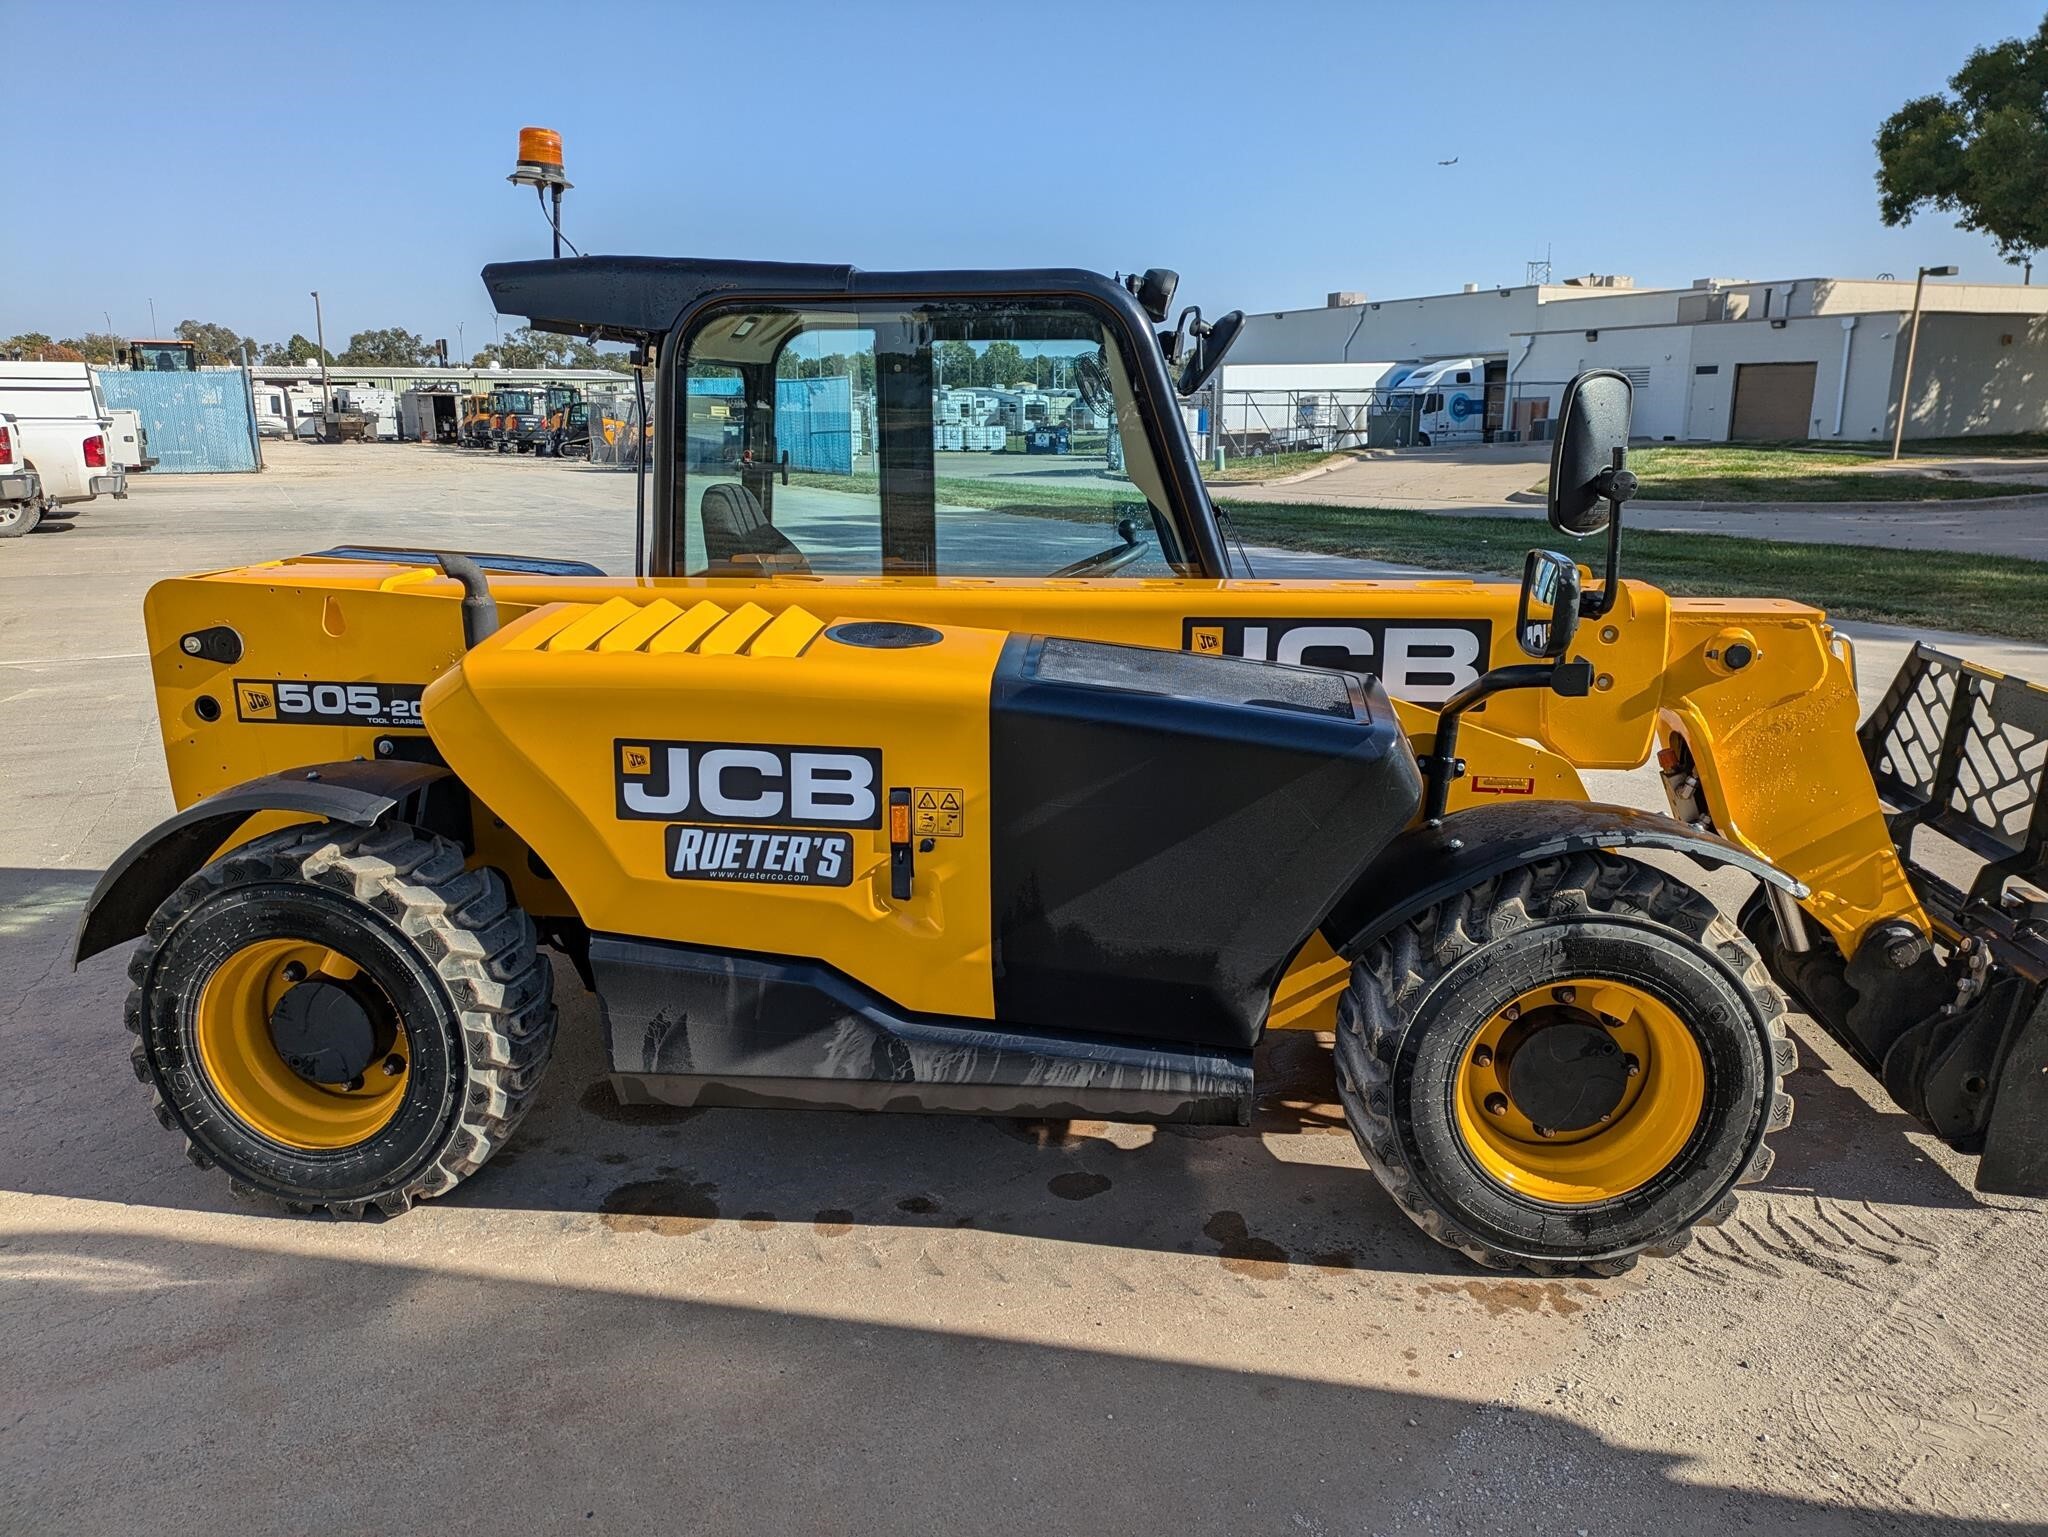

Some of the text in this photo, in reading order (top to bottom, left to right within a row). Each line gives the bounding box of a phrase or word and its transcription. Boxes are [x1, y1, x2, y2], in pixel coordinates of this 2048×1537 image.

[1200, 635, 1218, 650] JCB
[248, 692, 270, 710] JCB
[630, 753, 647, 767] JCB
[623, 747, 876, 821] JCB
[673, 828, 846, 879] RUETER'S
[709, 870, 810, 882] www.rueterco.com
